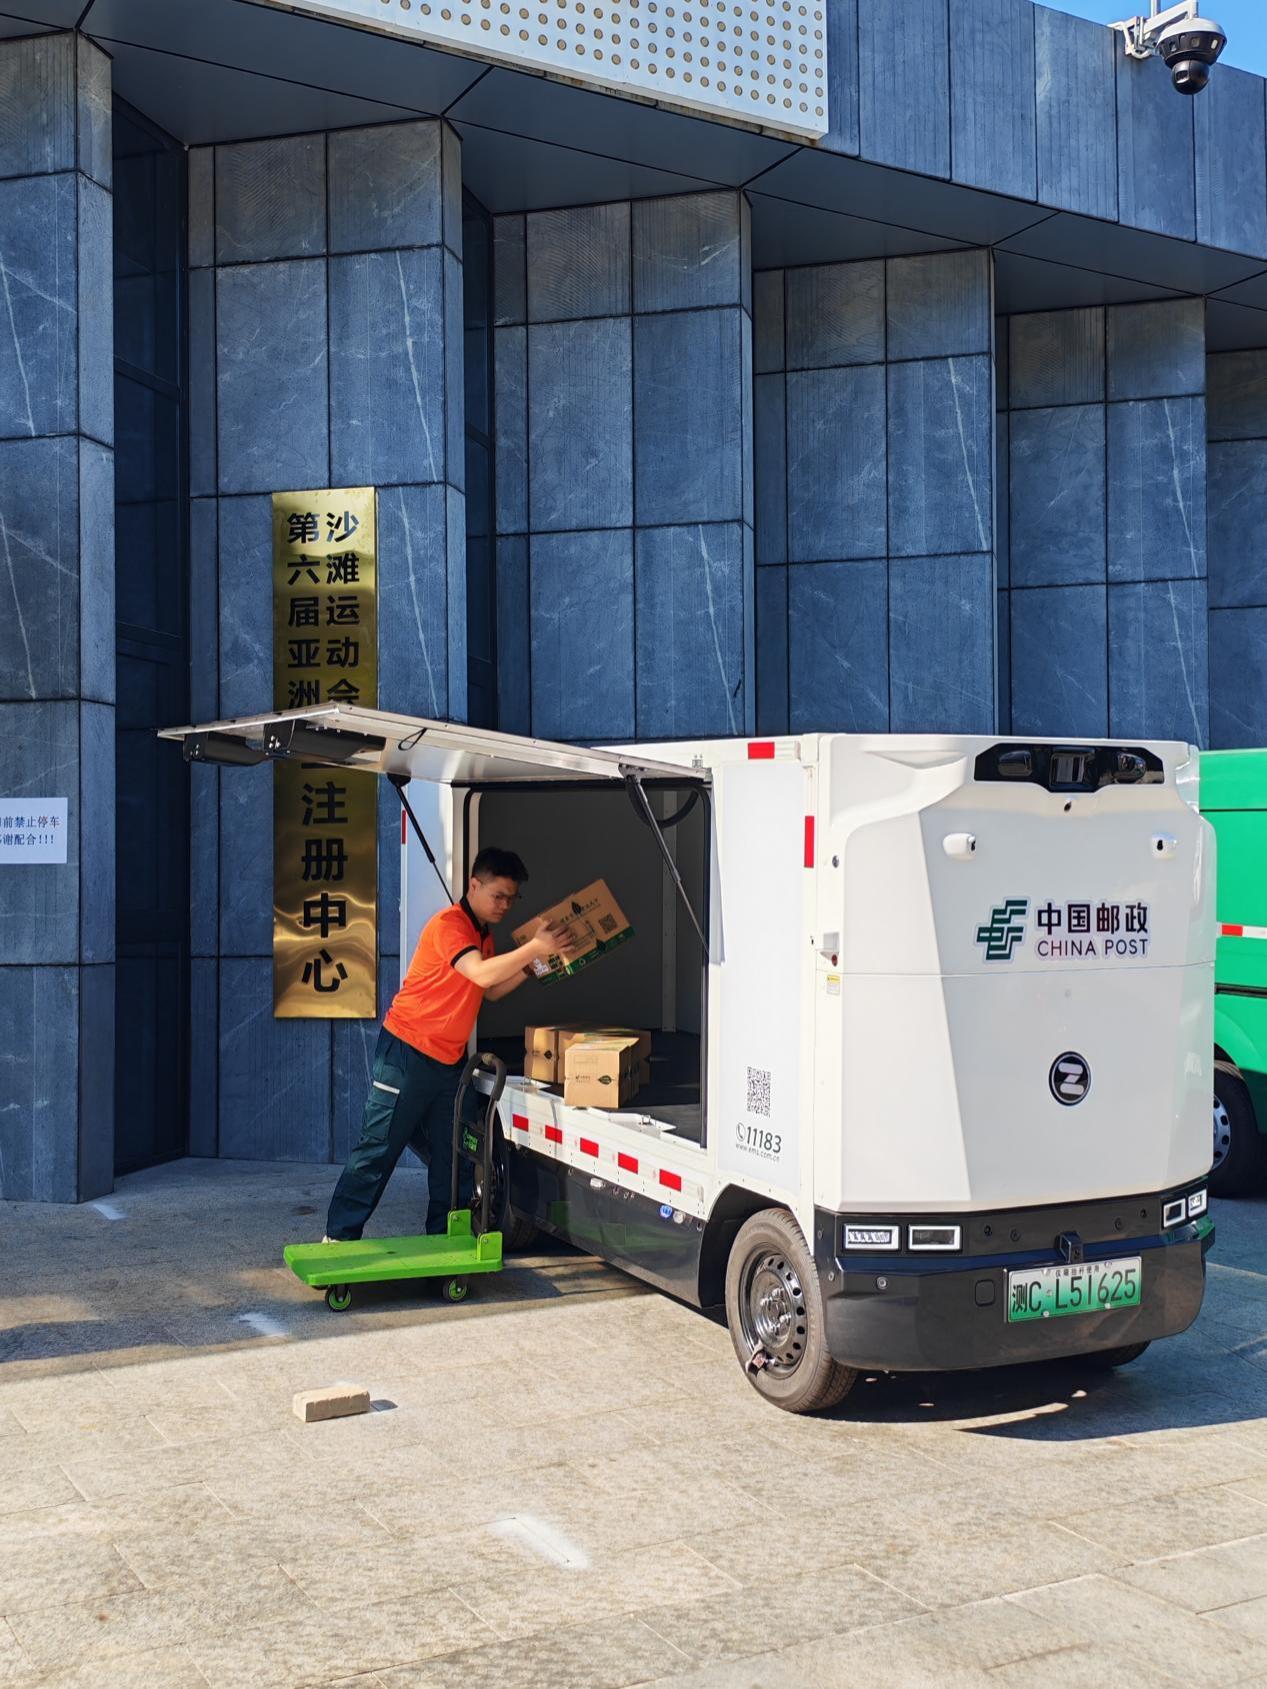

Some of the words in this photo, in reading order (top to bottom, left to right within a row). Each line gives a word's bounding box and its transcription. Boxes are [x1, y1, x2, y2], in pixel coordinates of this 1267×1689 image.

[287, 512, 321, 707] 第六届亚洲
[326, 510, 360, 705] 沙滩运动会
[0, 816, 60, 828] 前禁止停车
[0, 833, 54, 845] 谢配合!!!
[301, 762, 349, 993] 注册中心
[1037, 902, 1148, 935] 中国邮政
[1037, 940, 1097, 957] CHINA
[1104, 938, 1148, 955] POST
[747, 1126, 781, 1153] 11183
